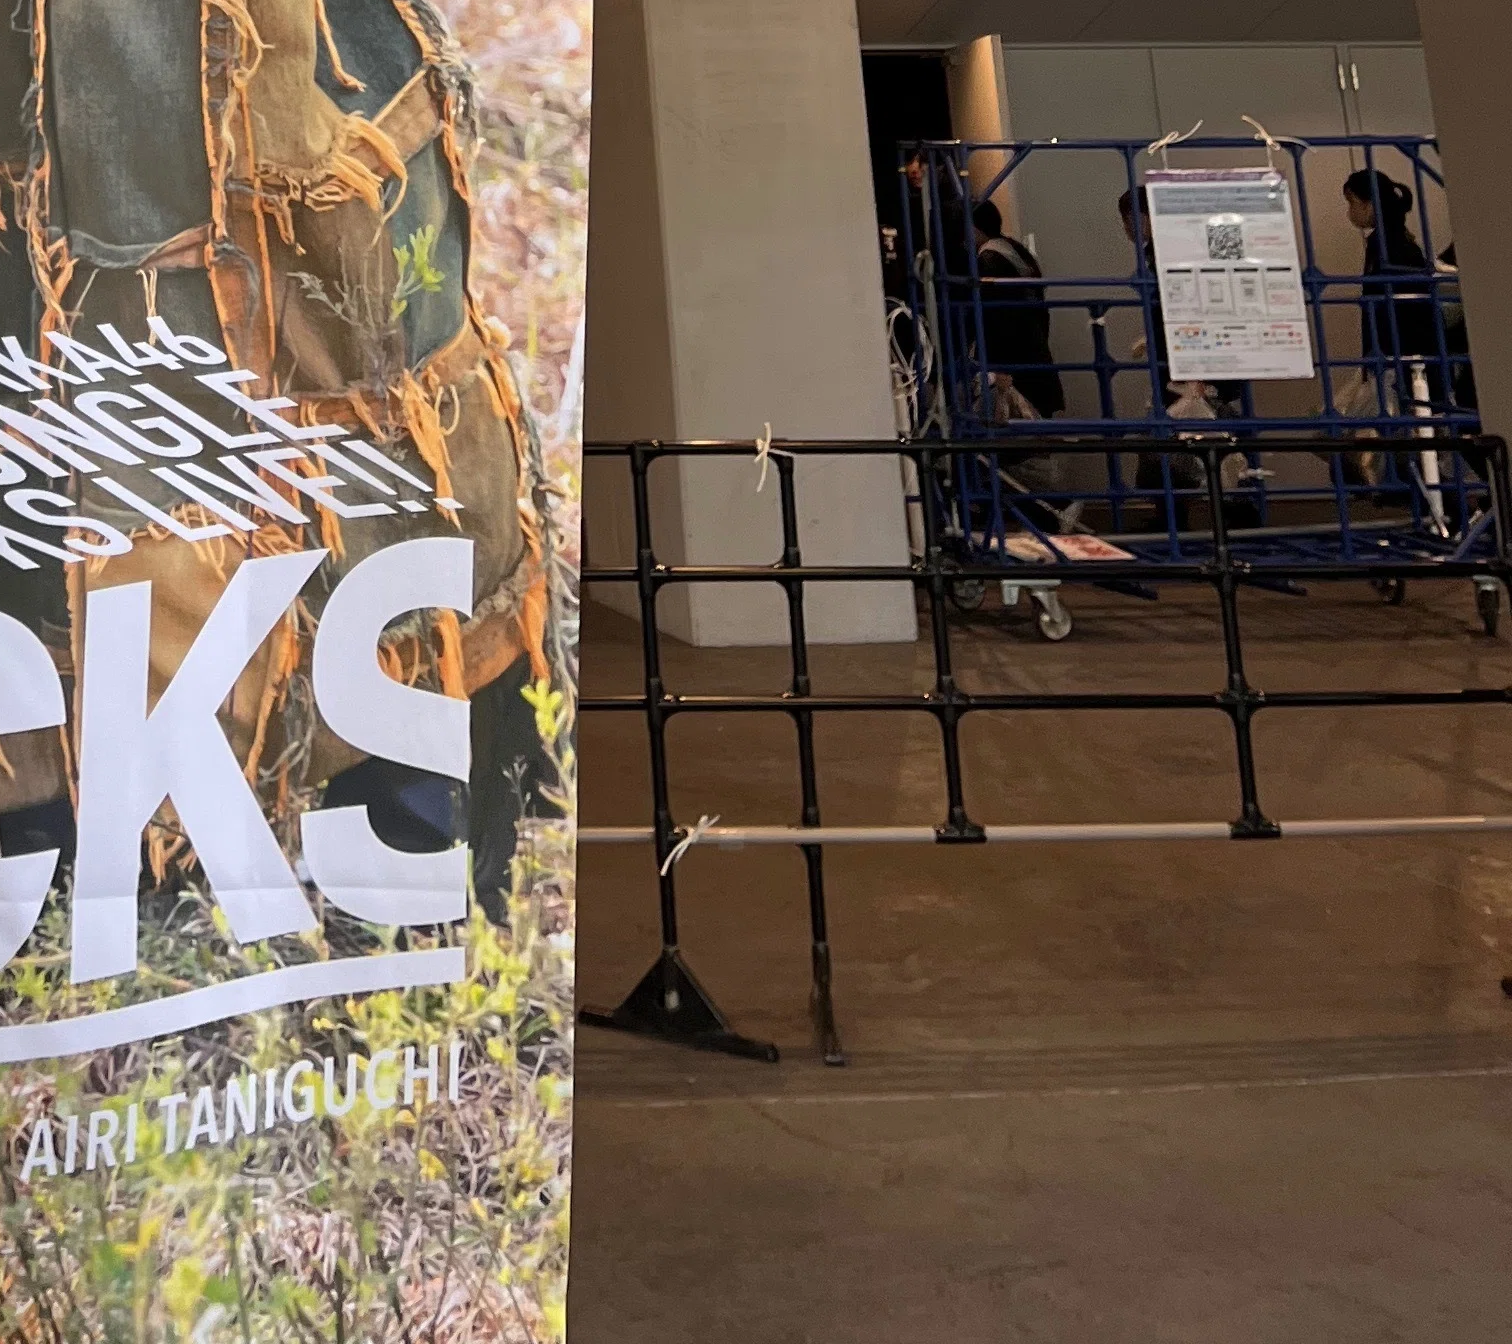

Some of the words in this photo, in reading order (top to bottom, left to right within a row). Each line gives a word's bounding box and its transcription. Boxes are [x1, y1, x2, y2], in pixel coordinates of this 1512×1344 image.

[91, 439, 465, 542] LIVE!!
[19, 1103, 139, 1184] AIRI
[157, 1040, 466, 1156] TANIGUCHI
